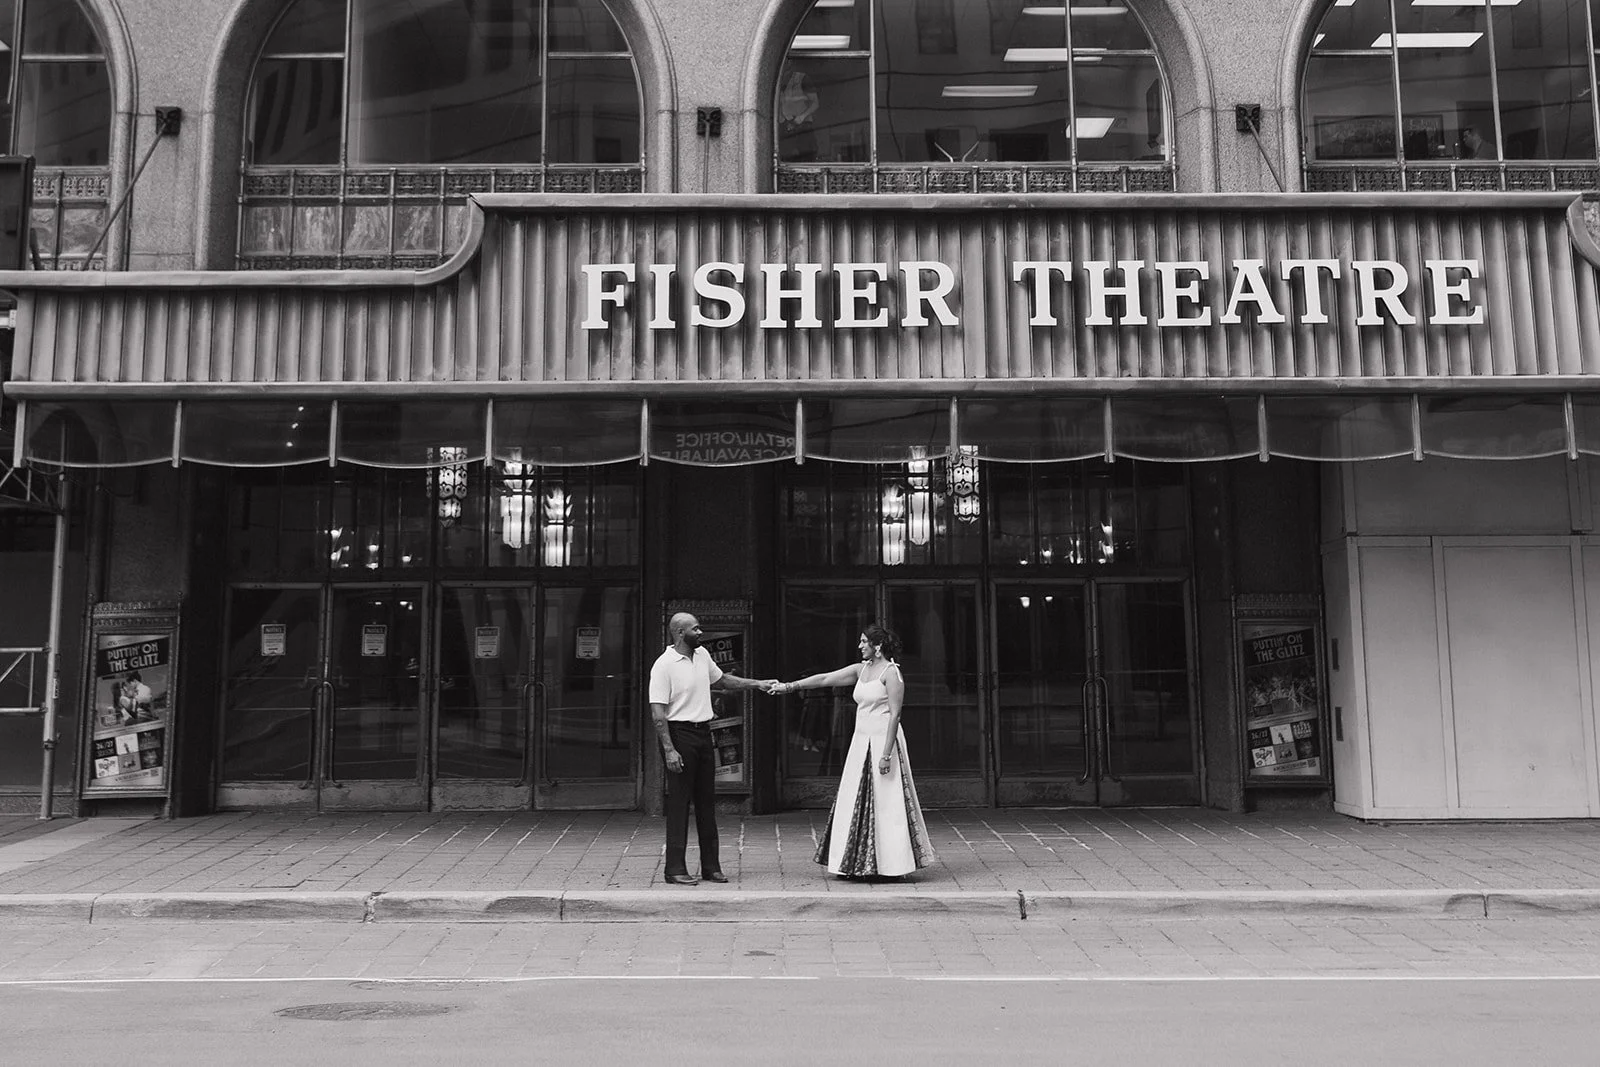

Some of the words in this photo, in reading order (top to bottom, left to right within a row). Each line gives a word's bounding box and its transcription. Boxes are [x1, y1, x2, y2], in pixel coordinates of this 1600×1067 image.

[581, 261, 959, 329] FISHER
[1012, 259, 1485, 327] THEATRE
[717, 640, 733, 650] ON
[1287, 633, 1303, 646] ON
[107, 645, 140, 660] PUTTIN'
[142, 642, 159, 654] ON
[712, 650, 735, 663] LITZ
[1255, 649, 1275, 662] THE
[1276, 644, 1305, 659] GLITZ
[108, 659, 128, 672] THE
[130, 653, 160, 668] GLITZ
